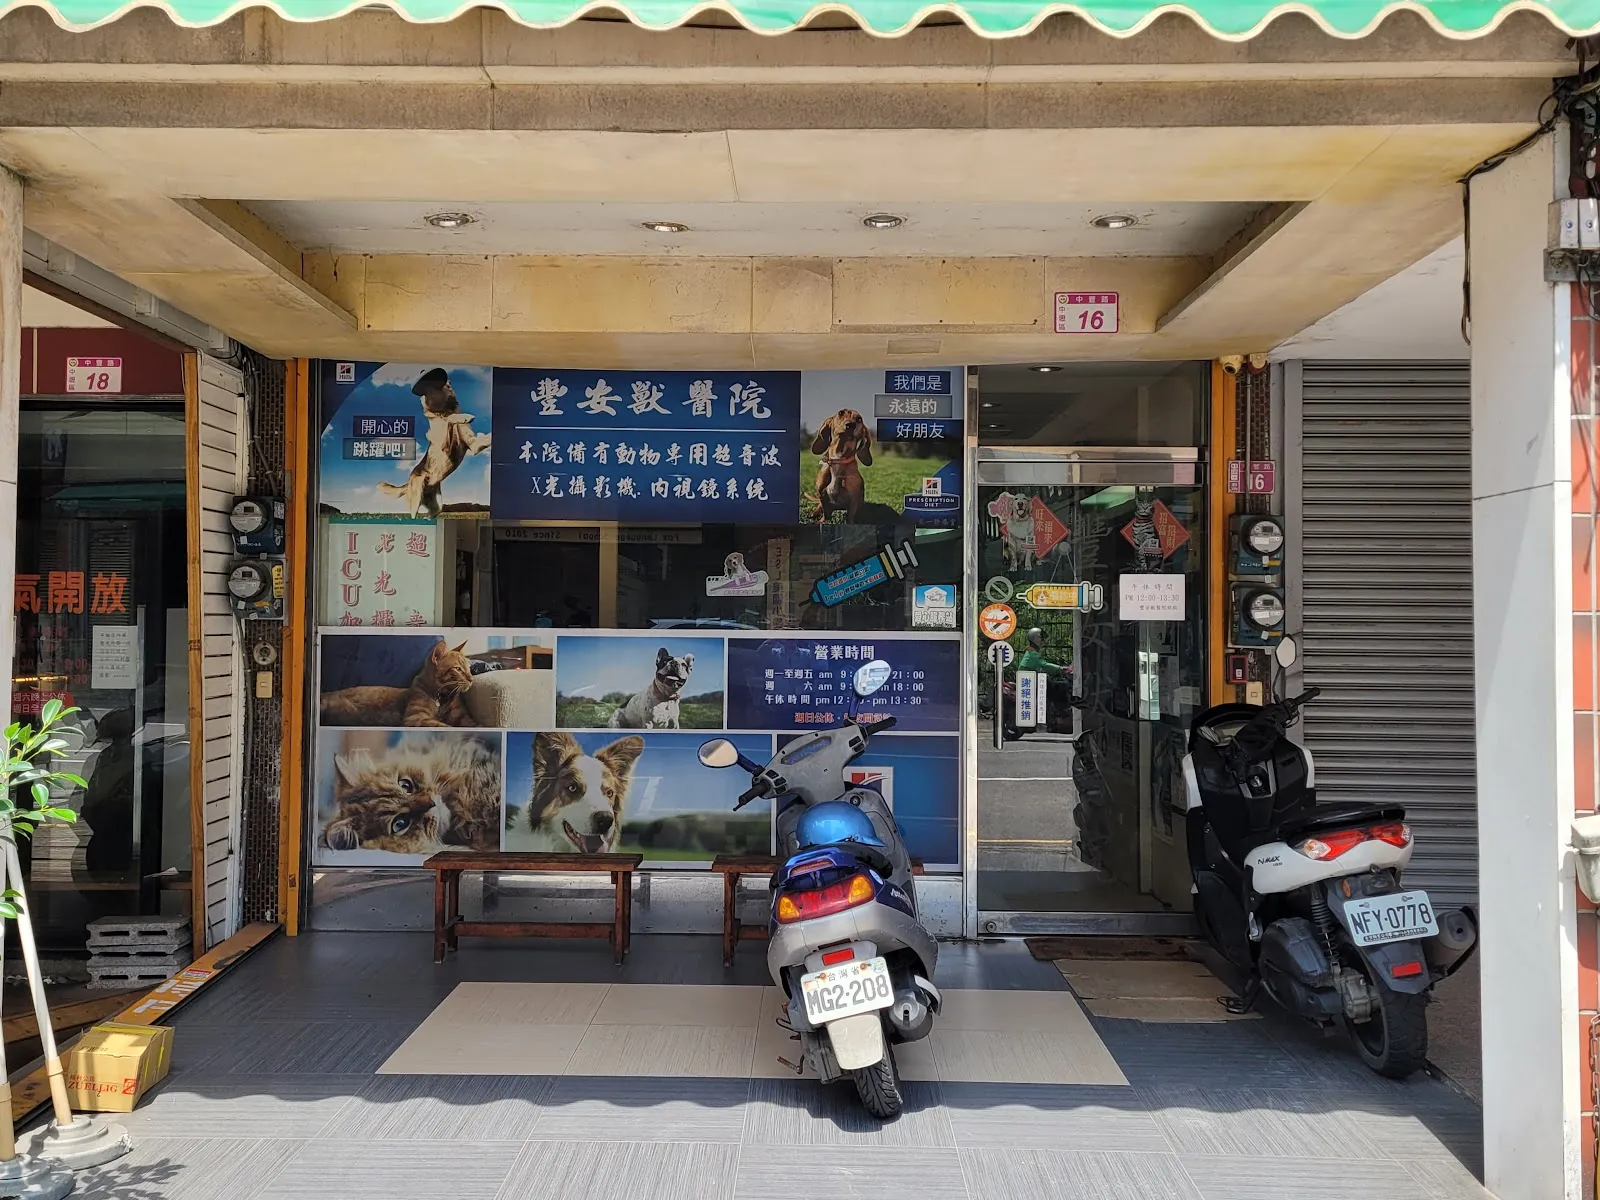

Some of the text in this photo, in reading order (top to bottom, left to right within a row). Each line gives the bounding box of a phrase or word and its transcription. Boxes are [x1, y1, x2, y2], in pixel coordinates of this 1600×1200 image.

[1078, 309, 1105, 330] 16
[86, 372, 110, 391] 18
[893, 374, 943, 391] 我們是
[530, 377, 772, 419] 豐安獸醫院
[888, 398, 938, 415] 永遠的
[361, 418, 410, 435] 開心的
[896, 422, 945, 439] 好朋友
[352, 441, 407, 458] 跳躍吧!
[518, 440, 782, 468] 本院備有動物專用超音波
[1249, 473, 1265, 491] 16
[15, 570, 128, 615] 氣開放
[814, 644, 876, 661] 營業時間
[764, 668, 814, 680] 週一至週五
[818, 672, 833, 680] am
[891, 670, 925, 680] 21:00
[817, 683, 833, 691] am
[890, 682, 925, 692] 18:00
[764, 694, 811, 705] 午休時間
[815, 697, 830, 707] pm
[872, 698, 888, 708] pm
[890, 695, 922, 706] 13:30
[1020, 677, 1032, 721] 謝絕推銷
[1257, 855, 1281, 865] NMAX
[67, 1080, 118, 1094] ZUELLIG
